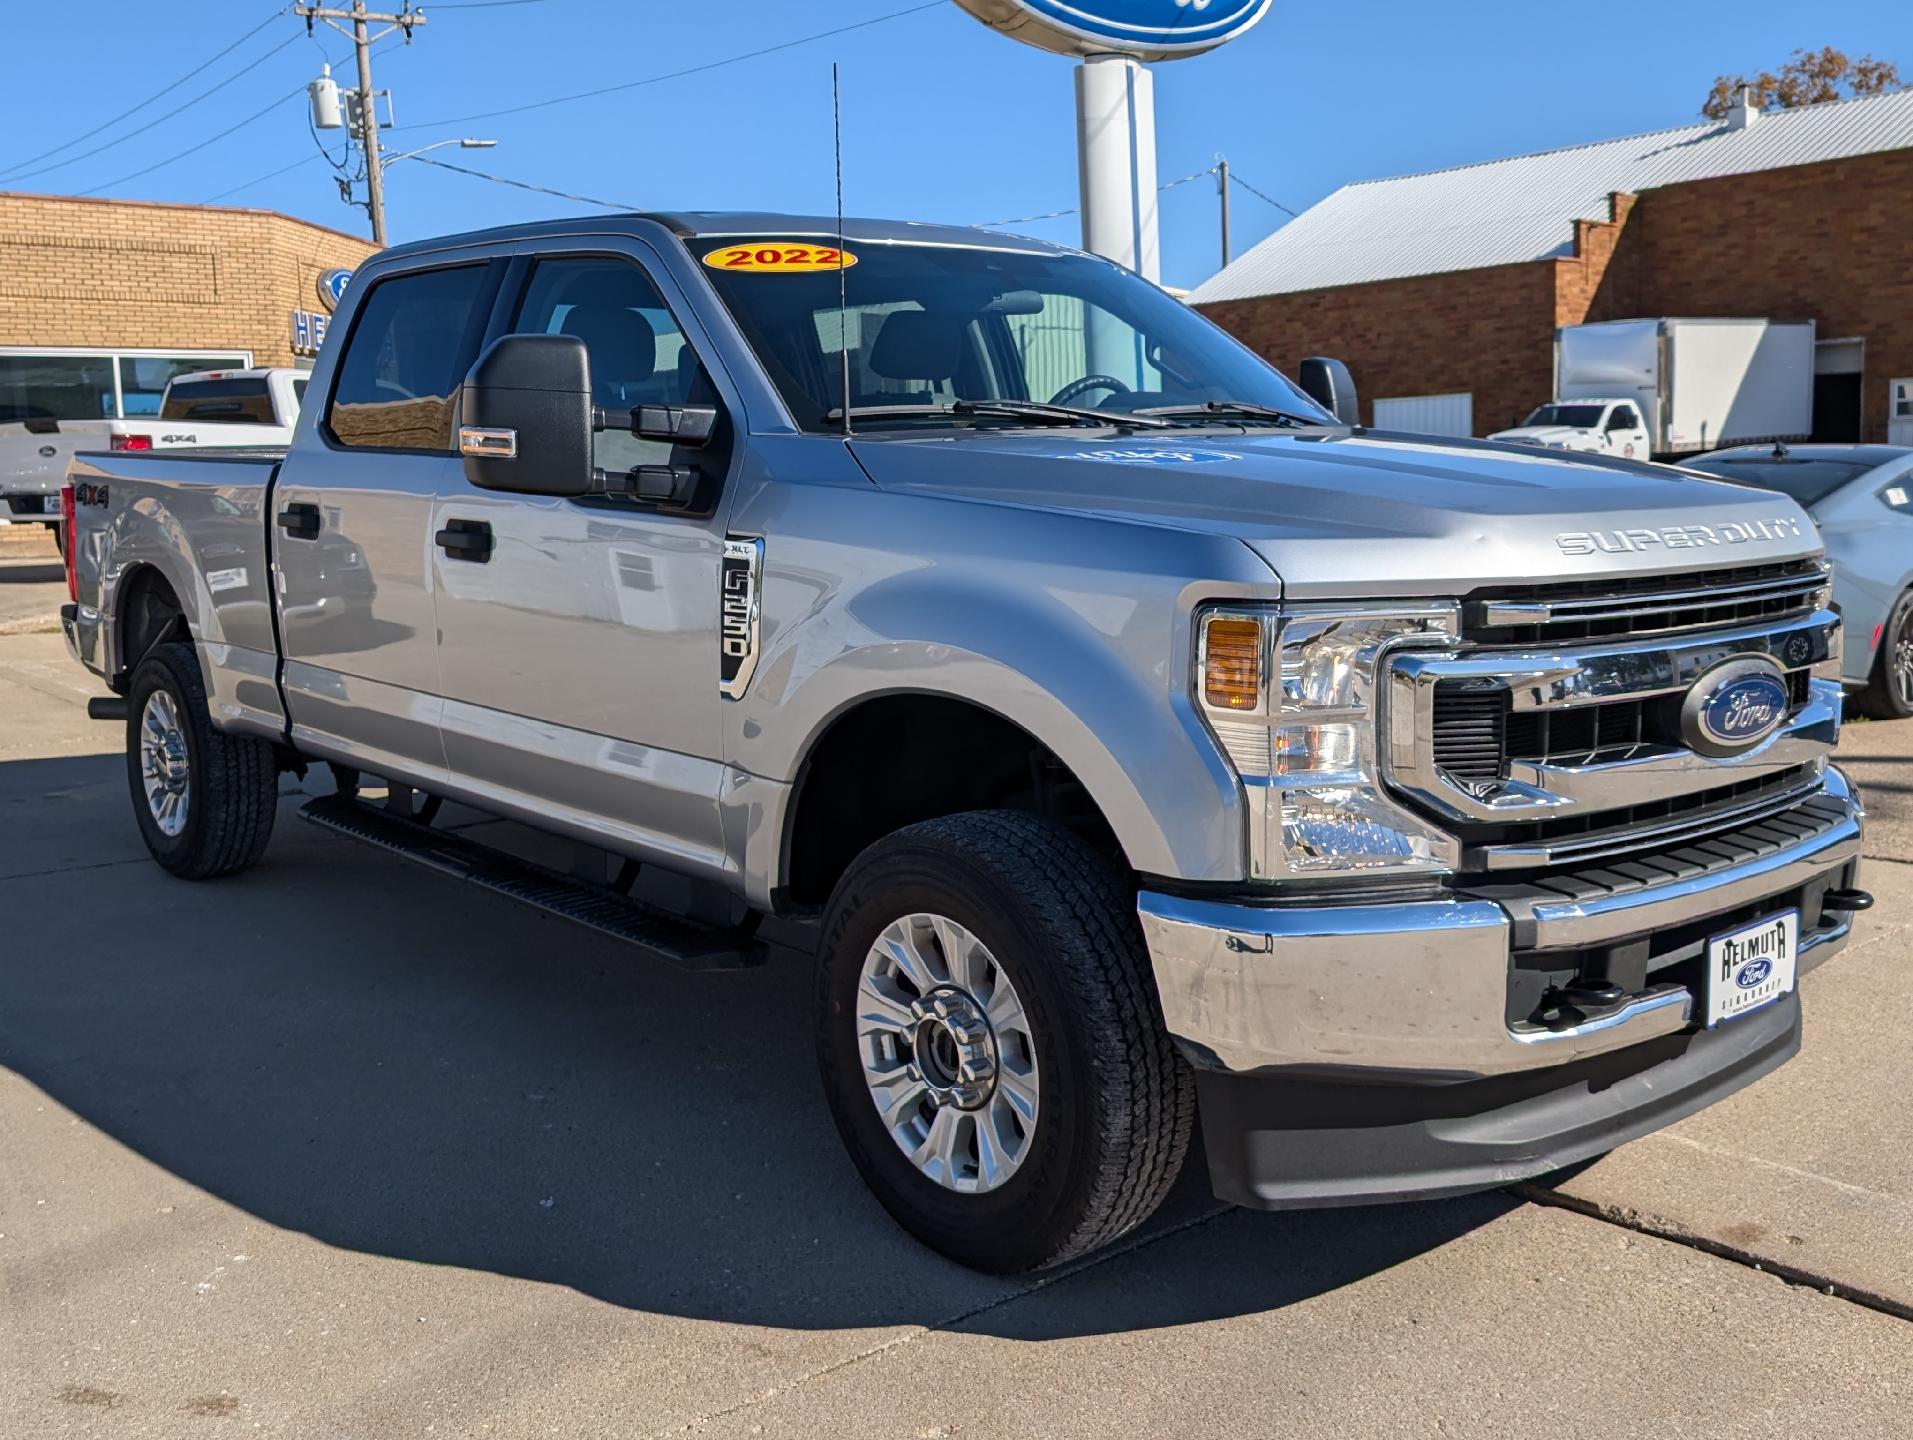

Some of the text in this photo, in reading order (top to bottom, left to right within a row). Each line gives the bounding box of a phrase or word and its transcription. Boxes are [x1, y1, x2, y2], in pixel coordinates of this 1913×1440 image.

[725, 248, 842, 267] 2022
[730, 544, 750, 555] XLT
[1554, 516, 1801, 556] SUPER DUTY
[1724, 687, 1773, 731] Ford
[1721, 920, 1786, 983] HELMUTH
[1742, 961, 1767, 985] Ford
